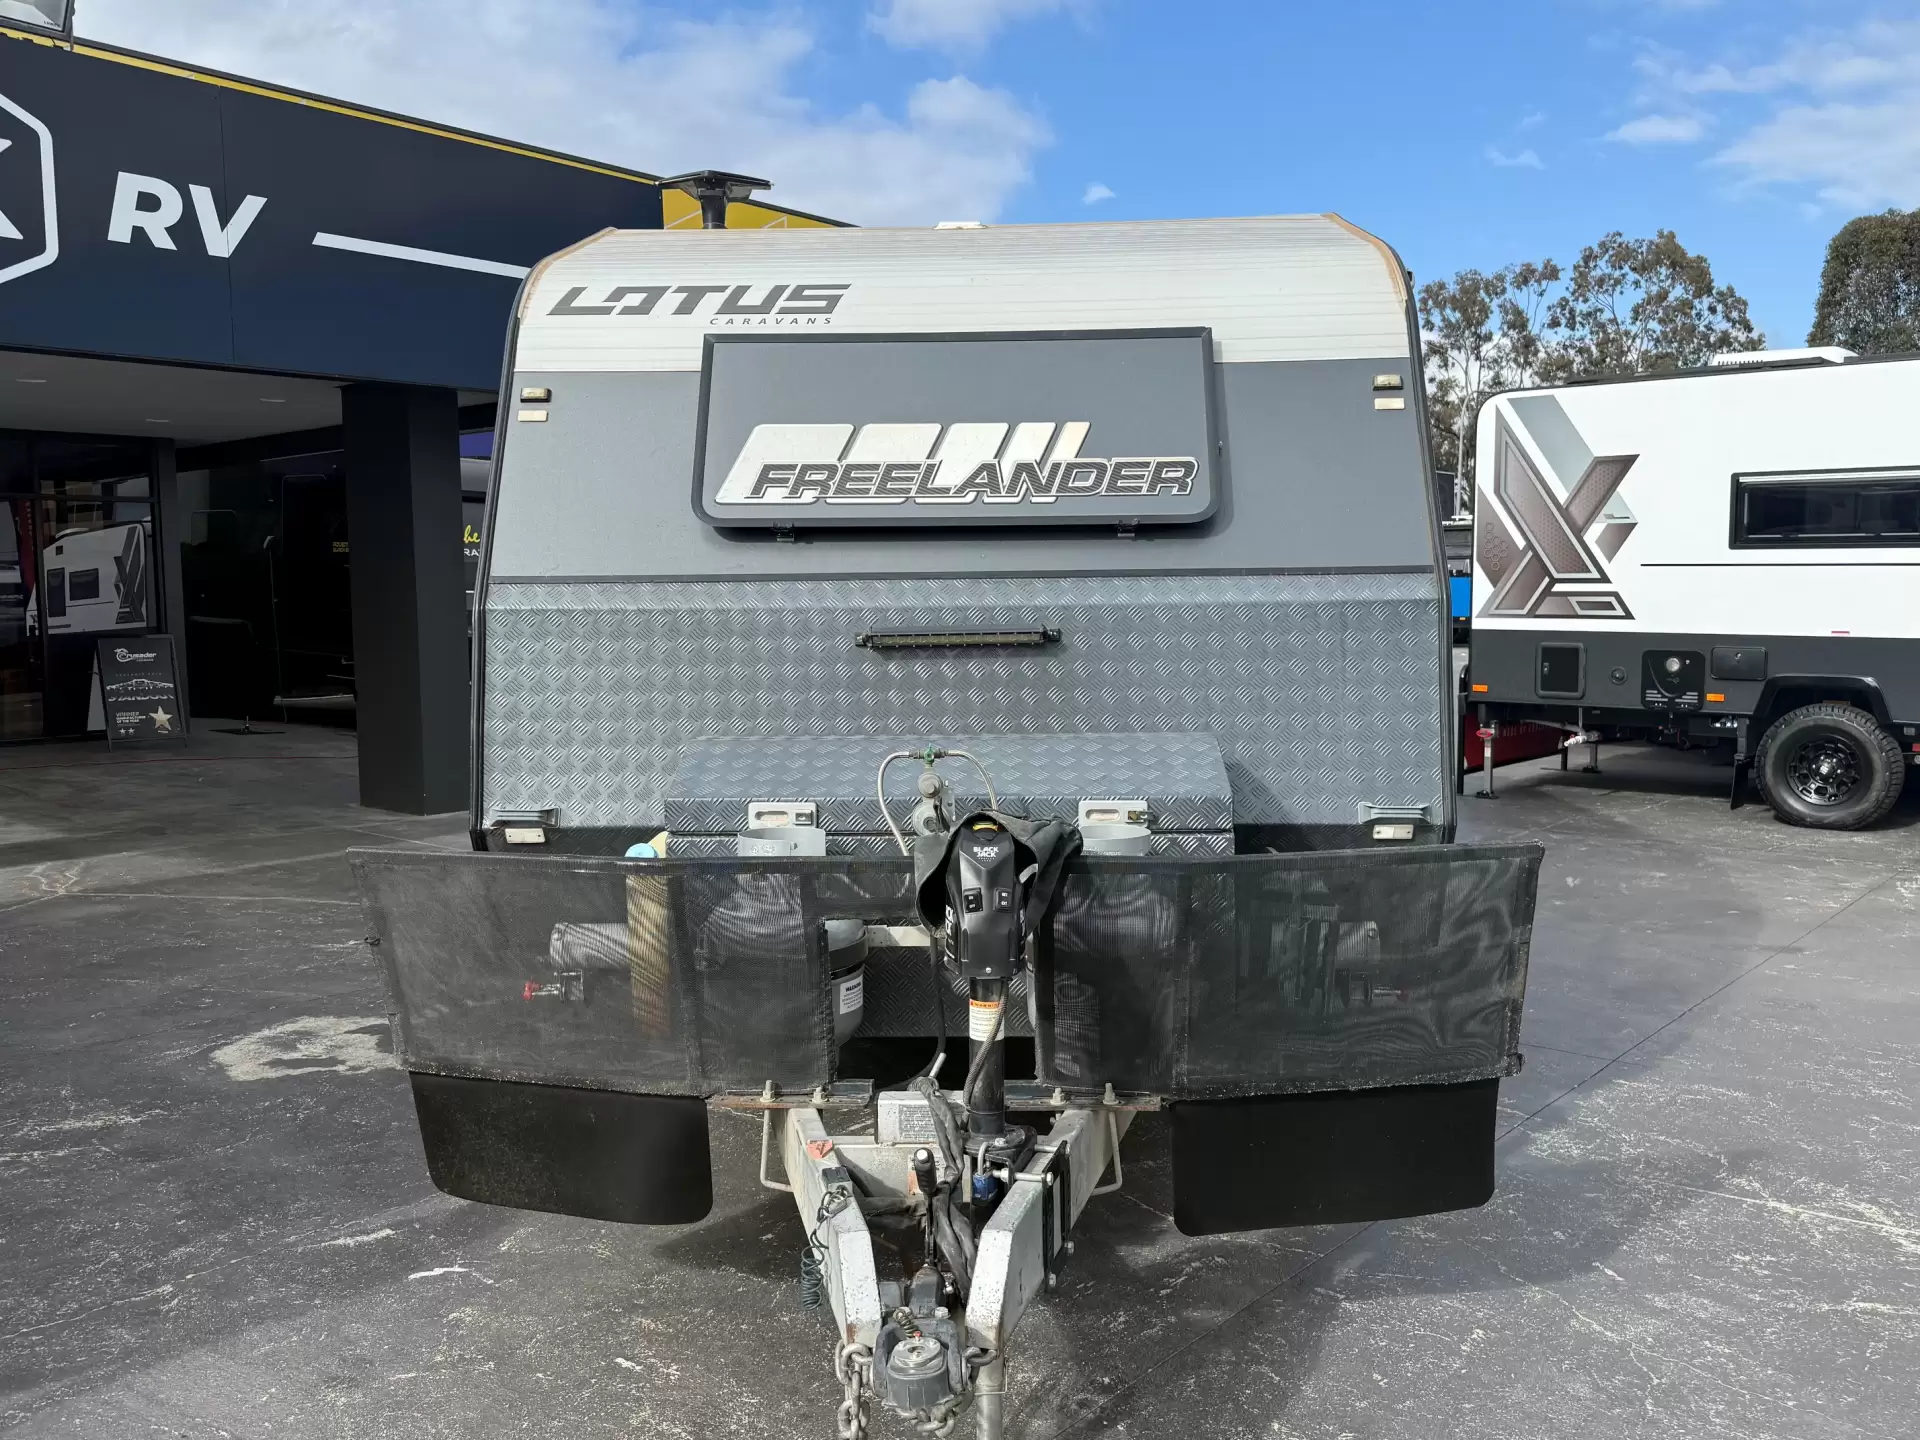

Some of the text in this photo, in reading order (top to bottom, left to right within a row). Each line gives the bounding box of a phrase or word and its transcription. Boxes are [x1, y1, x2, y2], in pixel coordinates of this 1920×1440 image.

[107, 171, 268, 258] RV
[547, 284, 852, 315] LOTUS
[709, 316, 833, 326] CARAVANS
[747, 456, 1200, 500] FREELANDER
